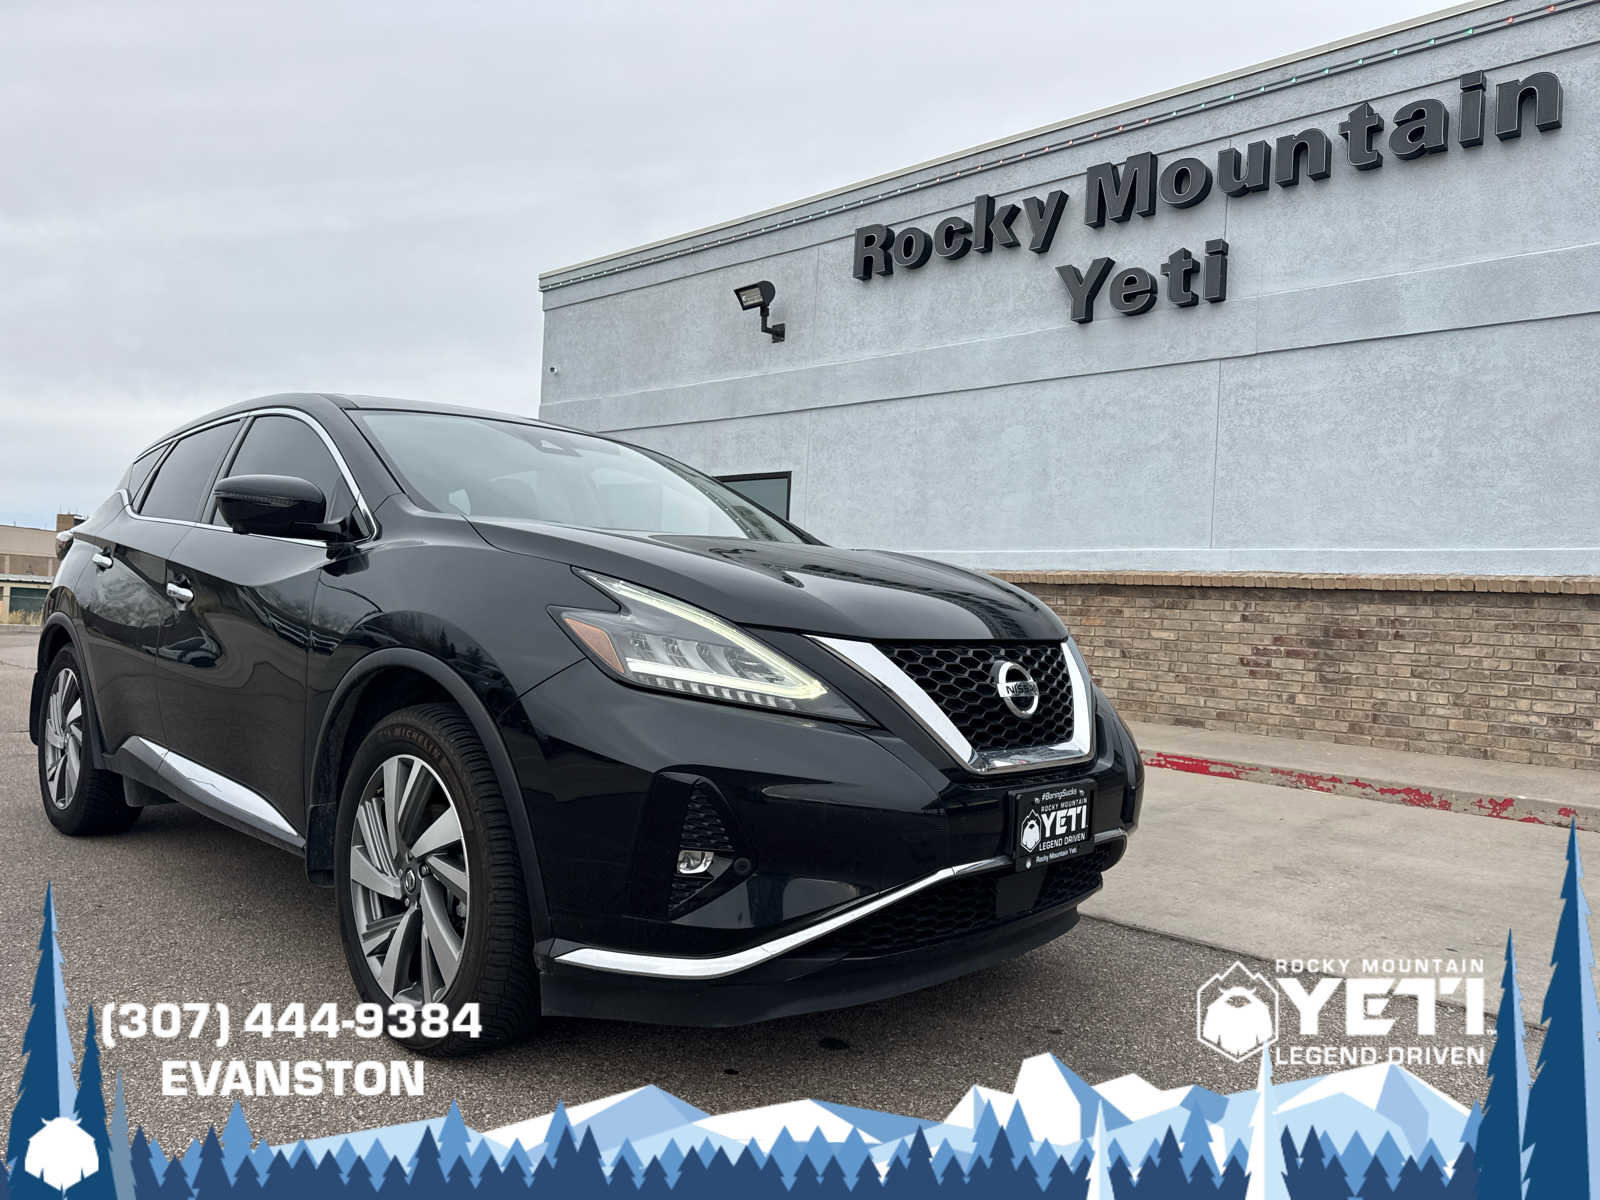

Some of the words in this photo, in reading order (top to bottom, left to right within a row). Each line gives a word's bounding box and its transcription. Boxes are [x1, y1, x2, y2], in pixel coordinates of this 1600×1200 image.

[853, 190, 1068, 280] Rocky
[1085, 71, 1562, 227] Mountain
[1055, 238, 1230, 324] Yeti
[1041, 804, 1059, 812] ROCKY
[1061, 798, 1087, 808] MOUNTAIN
[1041, 804, 1087, 838] YETI
[1039, 838, 1063, 851] LEGEND
[1064, 832, 1086, 845] DRIVEN
[1035, 855, 1049, 864] Rocky
[1049, 850, 1068, 860] Mountain
